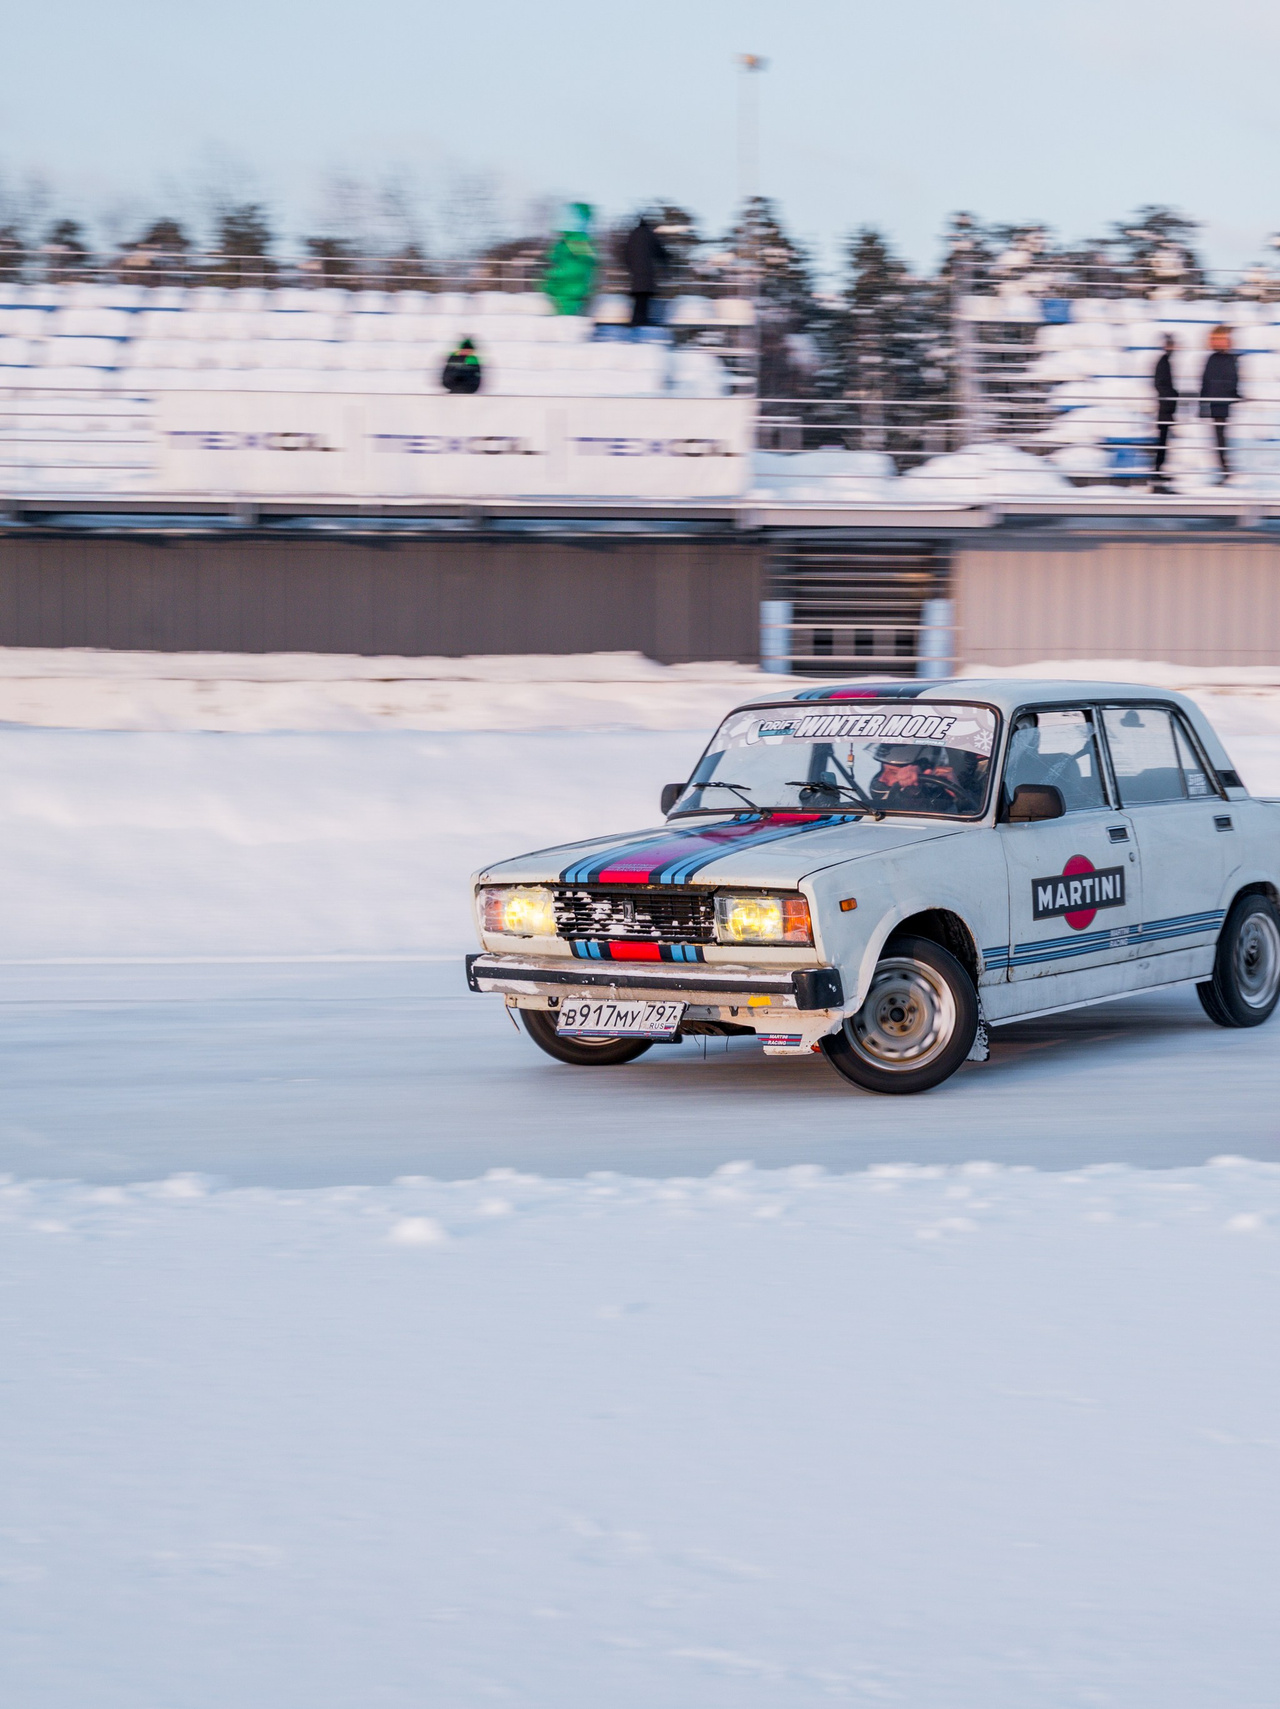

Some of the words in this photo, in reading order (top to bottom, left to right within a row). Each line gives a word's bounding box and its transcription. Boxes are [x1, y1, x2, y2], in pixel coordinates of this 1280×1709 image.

[761, 719, 801, 732] DRIFT
[794, 714, 887, 738] WINTER
[879, 714, 957, 740] MODE
[1037, 874, 1122, 912] MARTINI
[645, 1004, 677, 1022] 797
[648, 1022, 665, 1030] RUS
